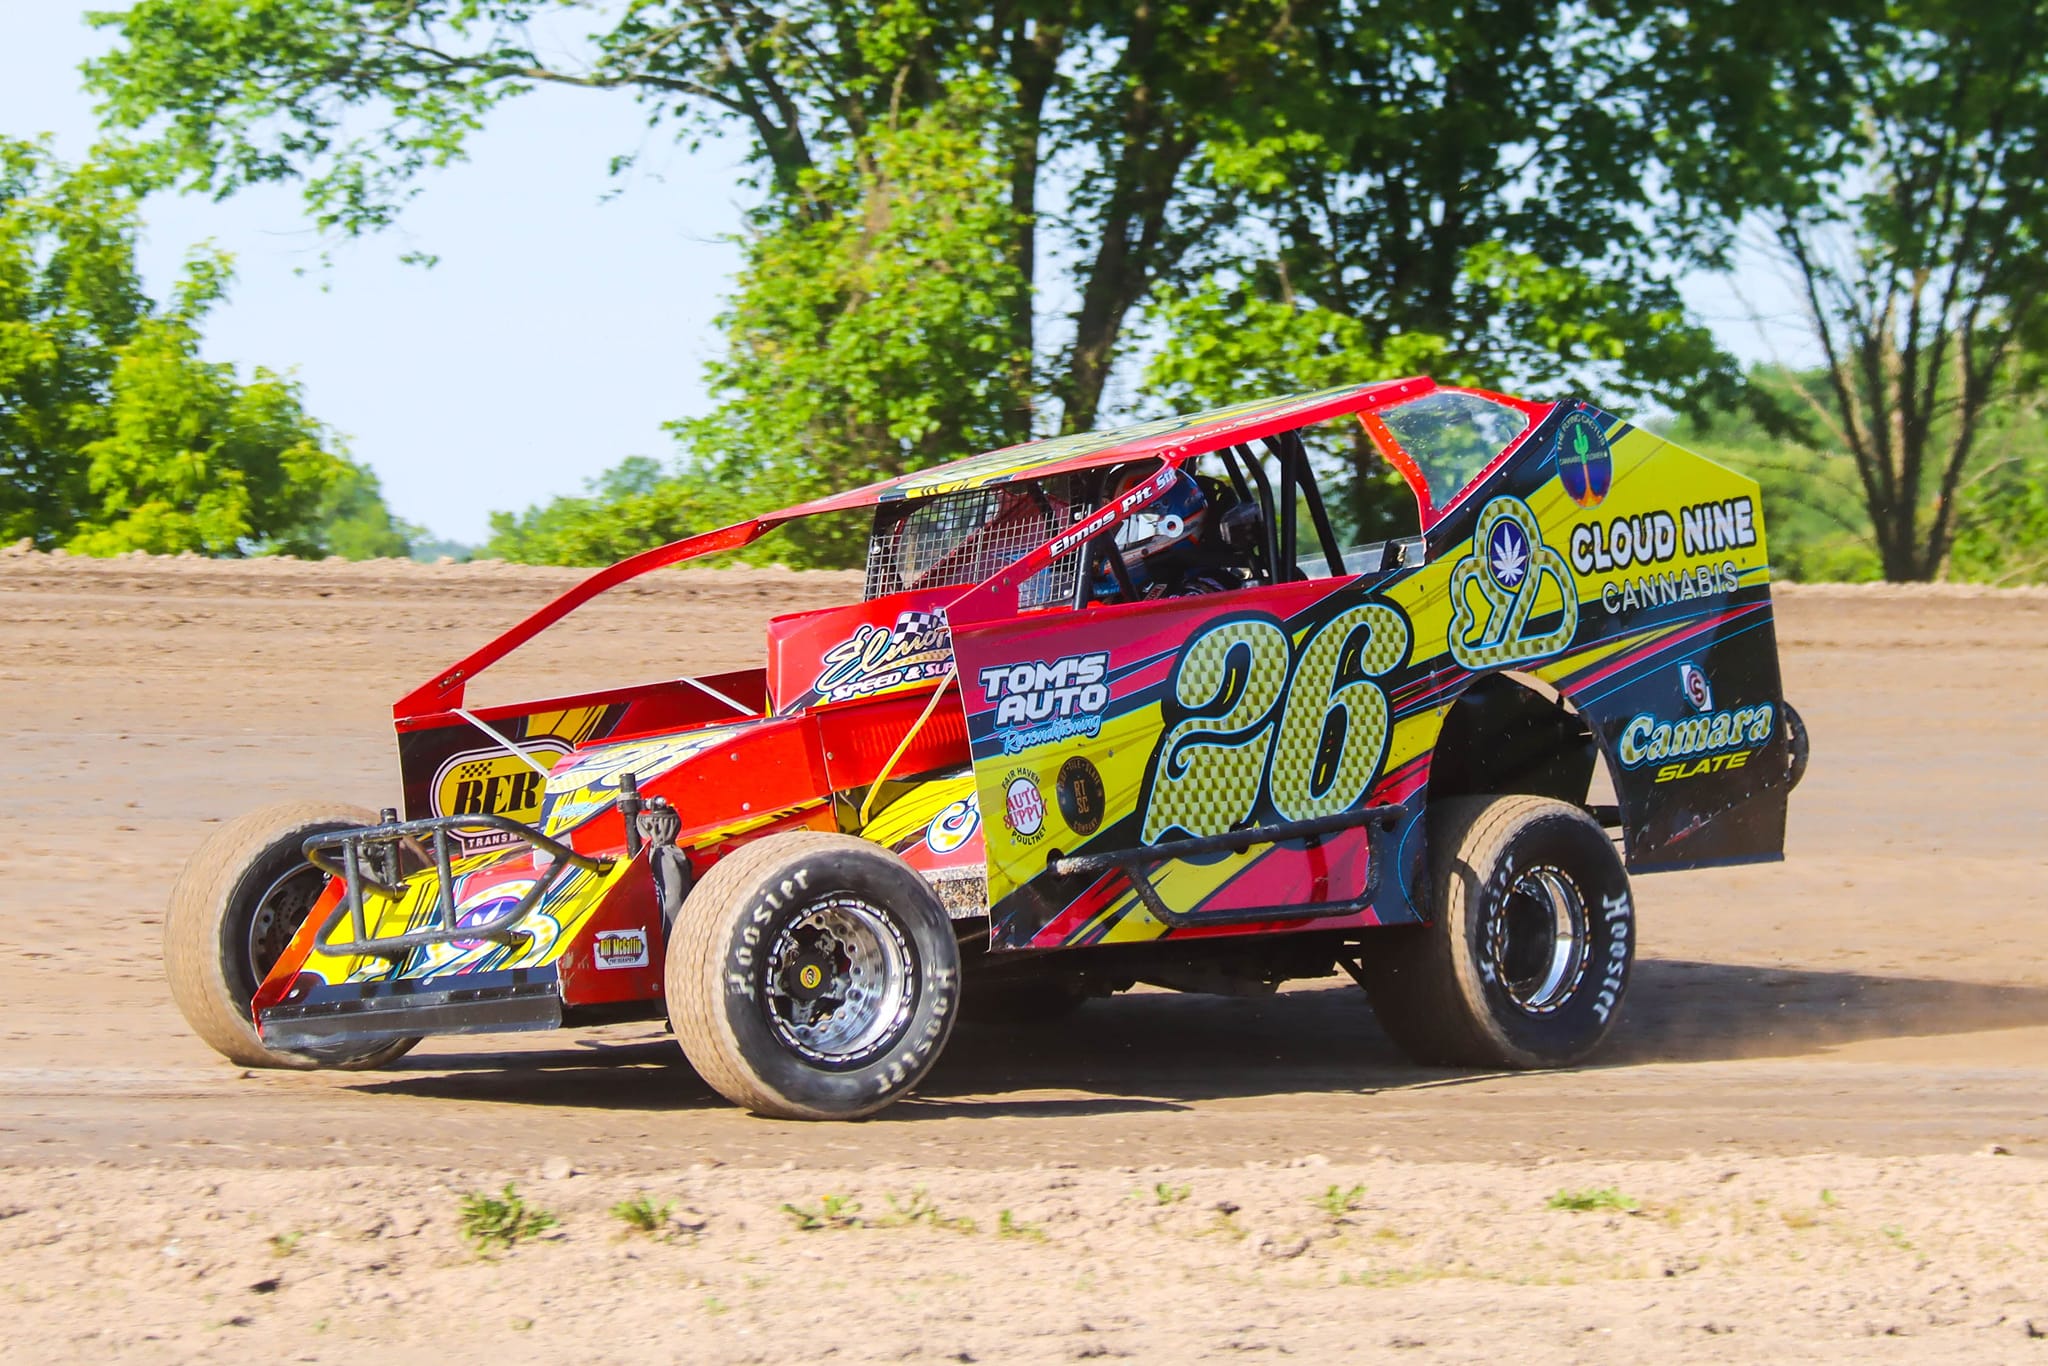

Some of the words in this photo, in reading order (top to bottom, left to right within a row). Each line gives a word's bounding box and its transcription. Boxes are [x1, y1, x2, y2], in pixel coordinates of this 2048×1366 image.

[1050, 511, 1117, 558] Elmos
[1121, 487, 1153, 513] Pit
[1571, 512, 1676, 576] CLOUD
[1681, 497, 1756, 557] NINE
[1601, 561, 1739, 615] CANNABIS
[831, 673, 902, 702] SPEED
[905, 667, 922, 680] &
[925, 662, 956, 677] SUP
[981, 654, 1107, 698] TOM'S
[996, 683, 1109, 725] AUTO
[1140, 604, 1409, 846] 26
[999, 715, 1101, 755] Reconditioning
[1620, 705, 1774, 766] Camara
[1001, 769, 1016, 790] FAIR
[1016, 767, 1041, 785] HAVEN
[1655, 751, 1752, 783] SLATE
[1003, 798, 1048, 830] SUPPLY
[1007, 787, 1041, 811] AUTO
[1011, 824, 1047, 846] POULTNEY
[1593, 890, 1631, 1025] Hoosier
